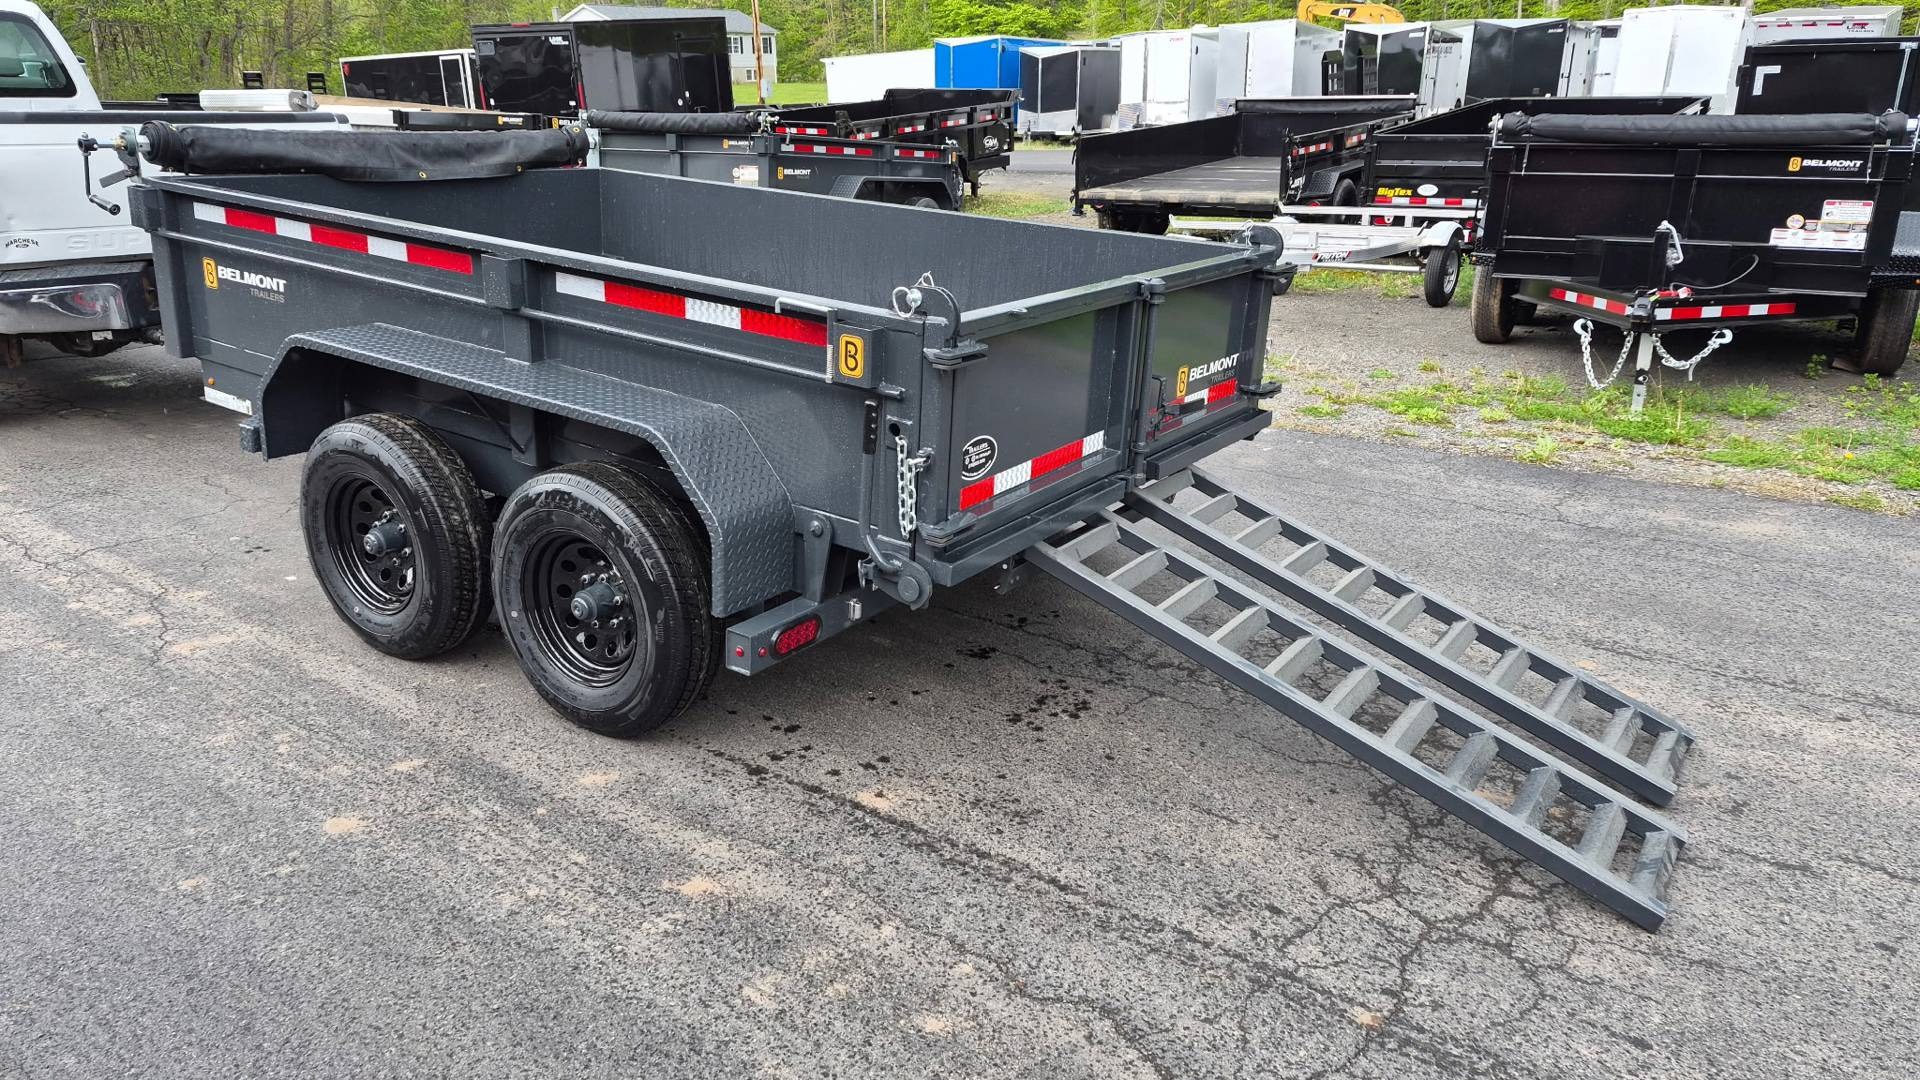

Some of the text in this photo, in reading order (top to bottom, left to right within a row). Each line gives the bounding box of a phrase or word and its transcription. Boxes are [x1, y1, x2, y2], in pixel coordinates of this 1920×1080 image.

[1802, 159, 1864, 168] BELMONT
[1376, 187, 1413, 197] BigTex
[217, 265, 287, 293] BELMONT
[249, 288, 286, 303] TRAILERS
[1189, 353, 1240, 382] BELMONT
